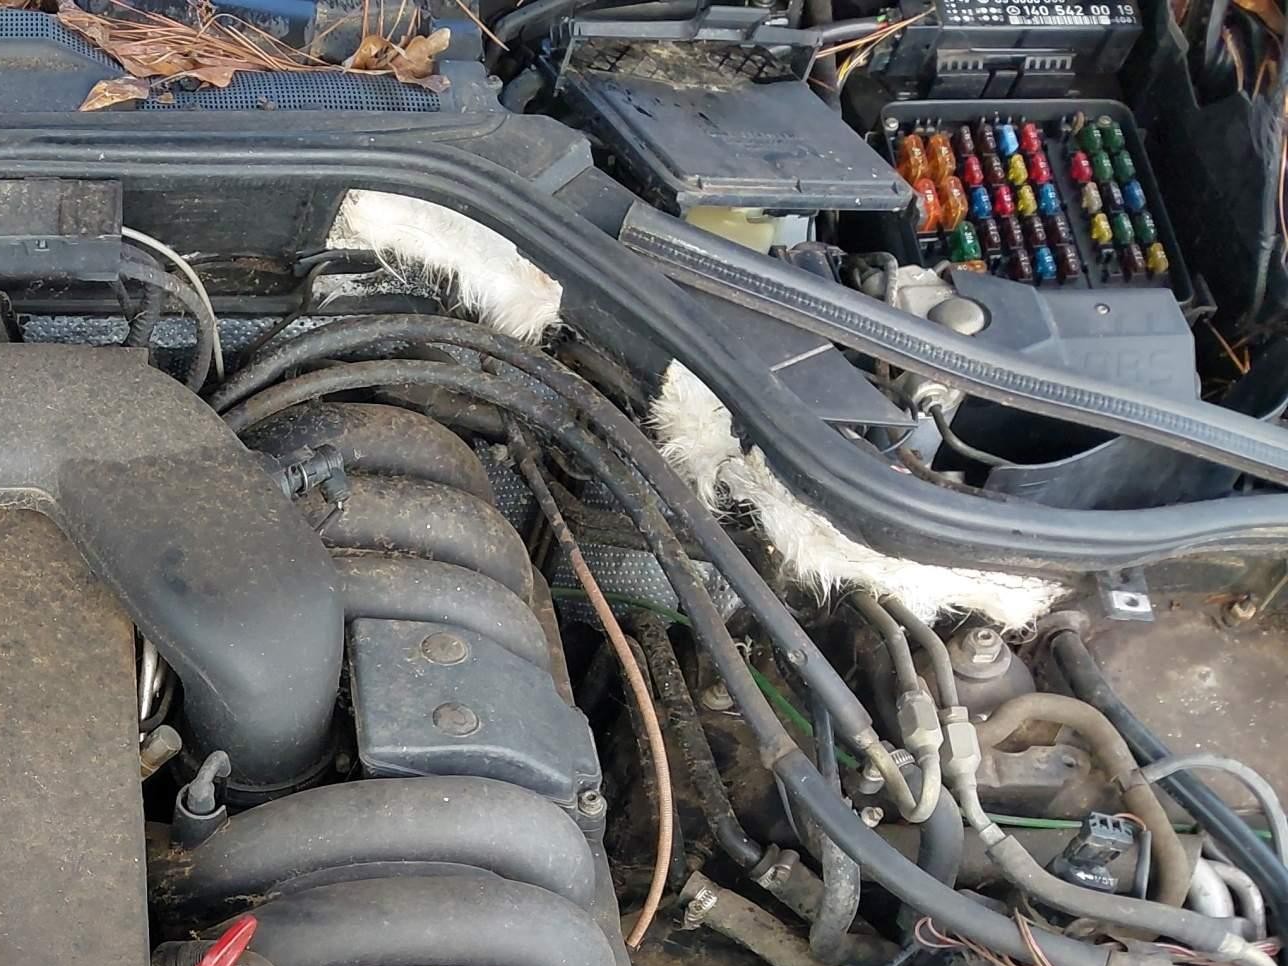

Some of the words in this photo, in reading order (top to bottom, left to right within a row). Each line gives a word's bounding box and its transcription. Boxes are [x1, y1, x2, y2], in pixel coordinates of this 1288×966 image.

[1023, 5, 1049, 16] 140
[1055, 5, 1085, 16] 542
[1090, 5, 1110, 16] 00
[1117, 5, 1134, 16] 19
